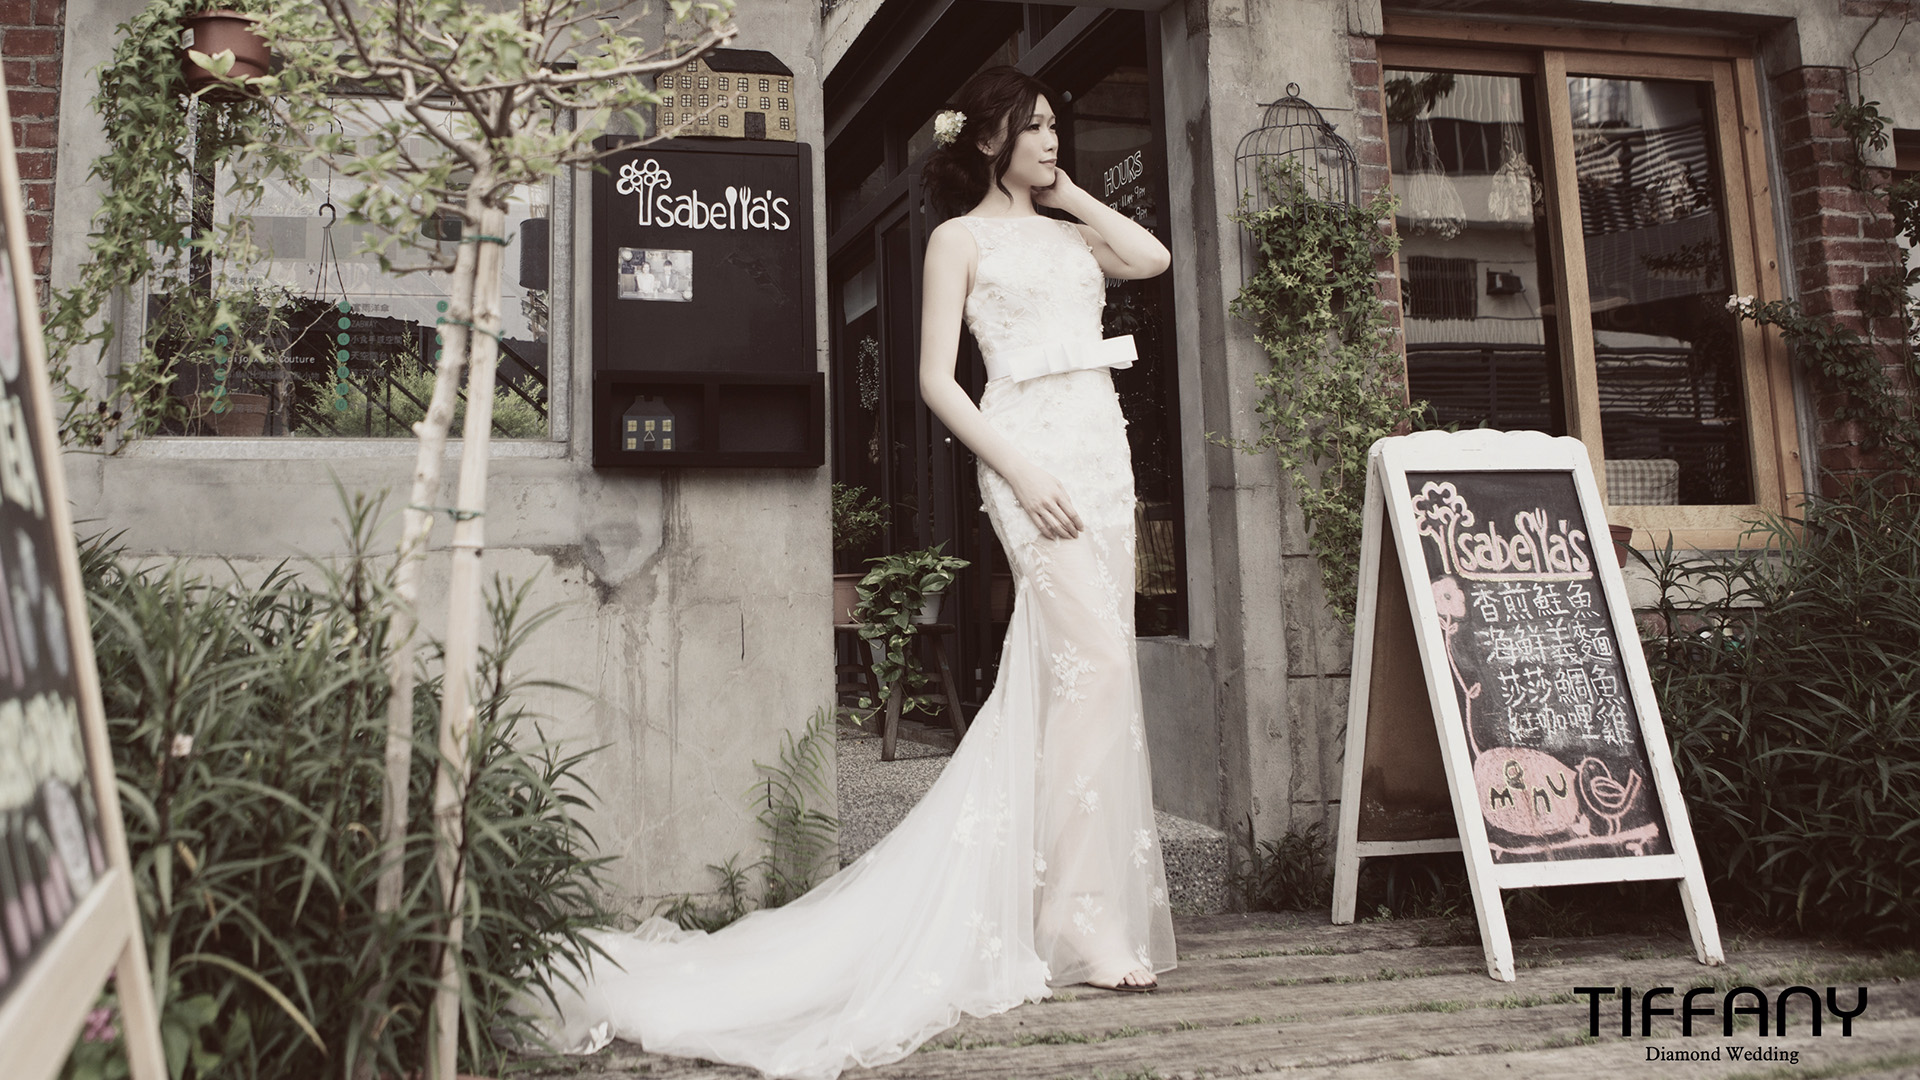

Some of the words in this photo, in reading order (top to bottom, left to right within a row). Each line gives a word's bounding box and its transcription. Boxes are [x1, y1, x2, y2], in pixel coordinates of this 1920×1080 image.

[616, 158, 791, 231] Isabella's
[1103, 150, 1144, 197] HOURS
[1471, 581, 1600, 622] 香煎鮭魚
[1498, 665, 1627, 708] 莎莎鯛魚
